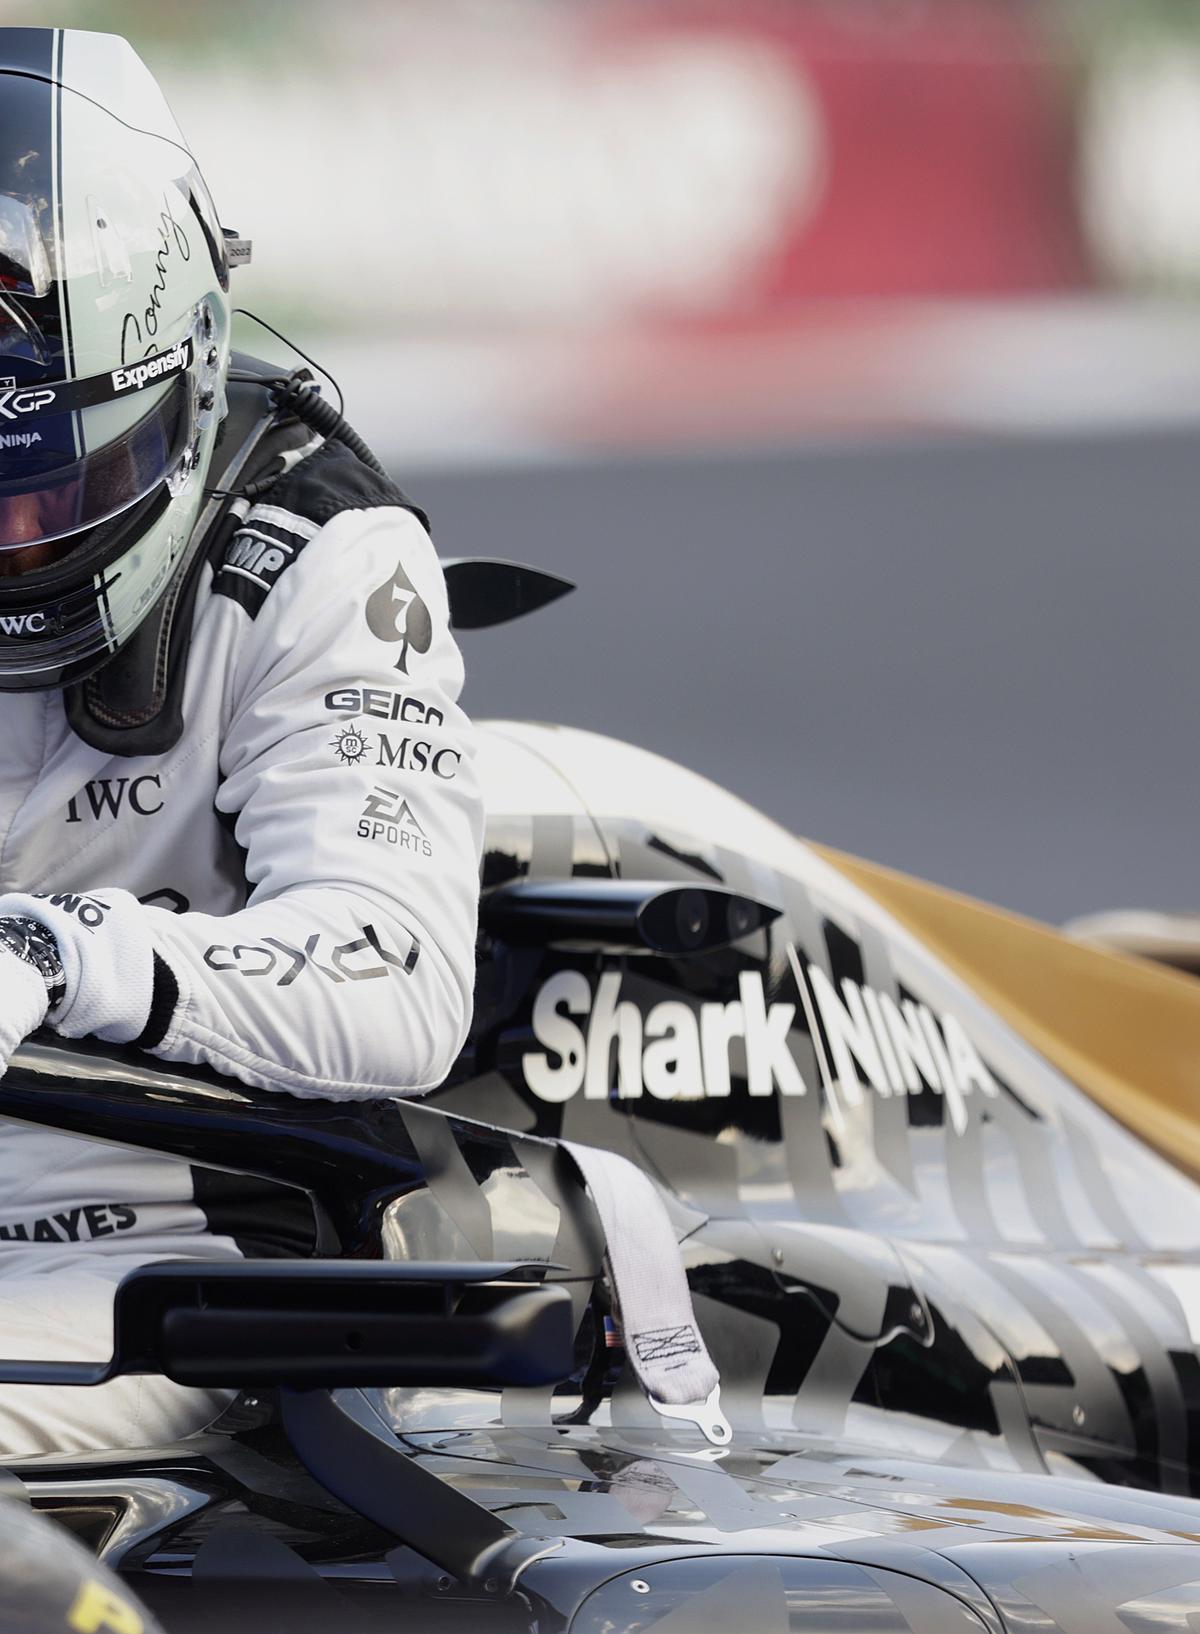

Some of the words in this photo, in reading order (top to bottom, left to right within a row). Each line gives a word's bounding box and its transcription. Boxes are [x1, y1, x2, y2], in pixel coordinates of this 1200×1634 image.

[111, 339, 191, 392] Expensify
[226, 536, 285, 576] MP
[391, 582, 417, 634] 7
[375, 733, 462, 780] MSC
[65, 774, 165, 823] IWC
[361, 785, 427, 838] EA
[356, 818, 433, 857] SPORTS
[30, 893, 105, 928] OM
[521, 969, 807, 1103] Shark
[807, 962, 1000, 1137] NINJA
